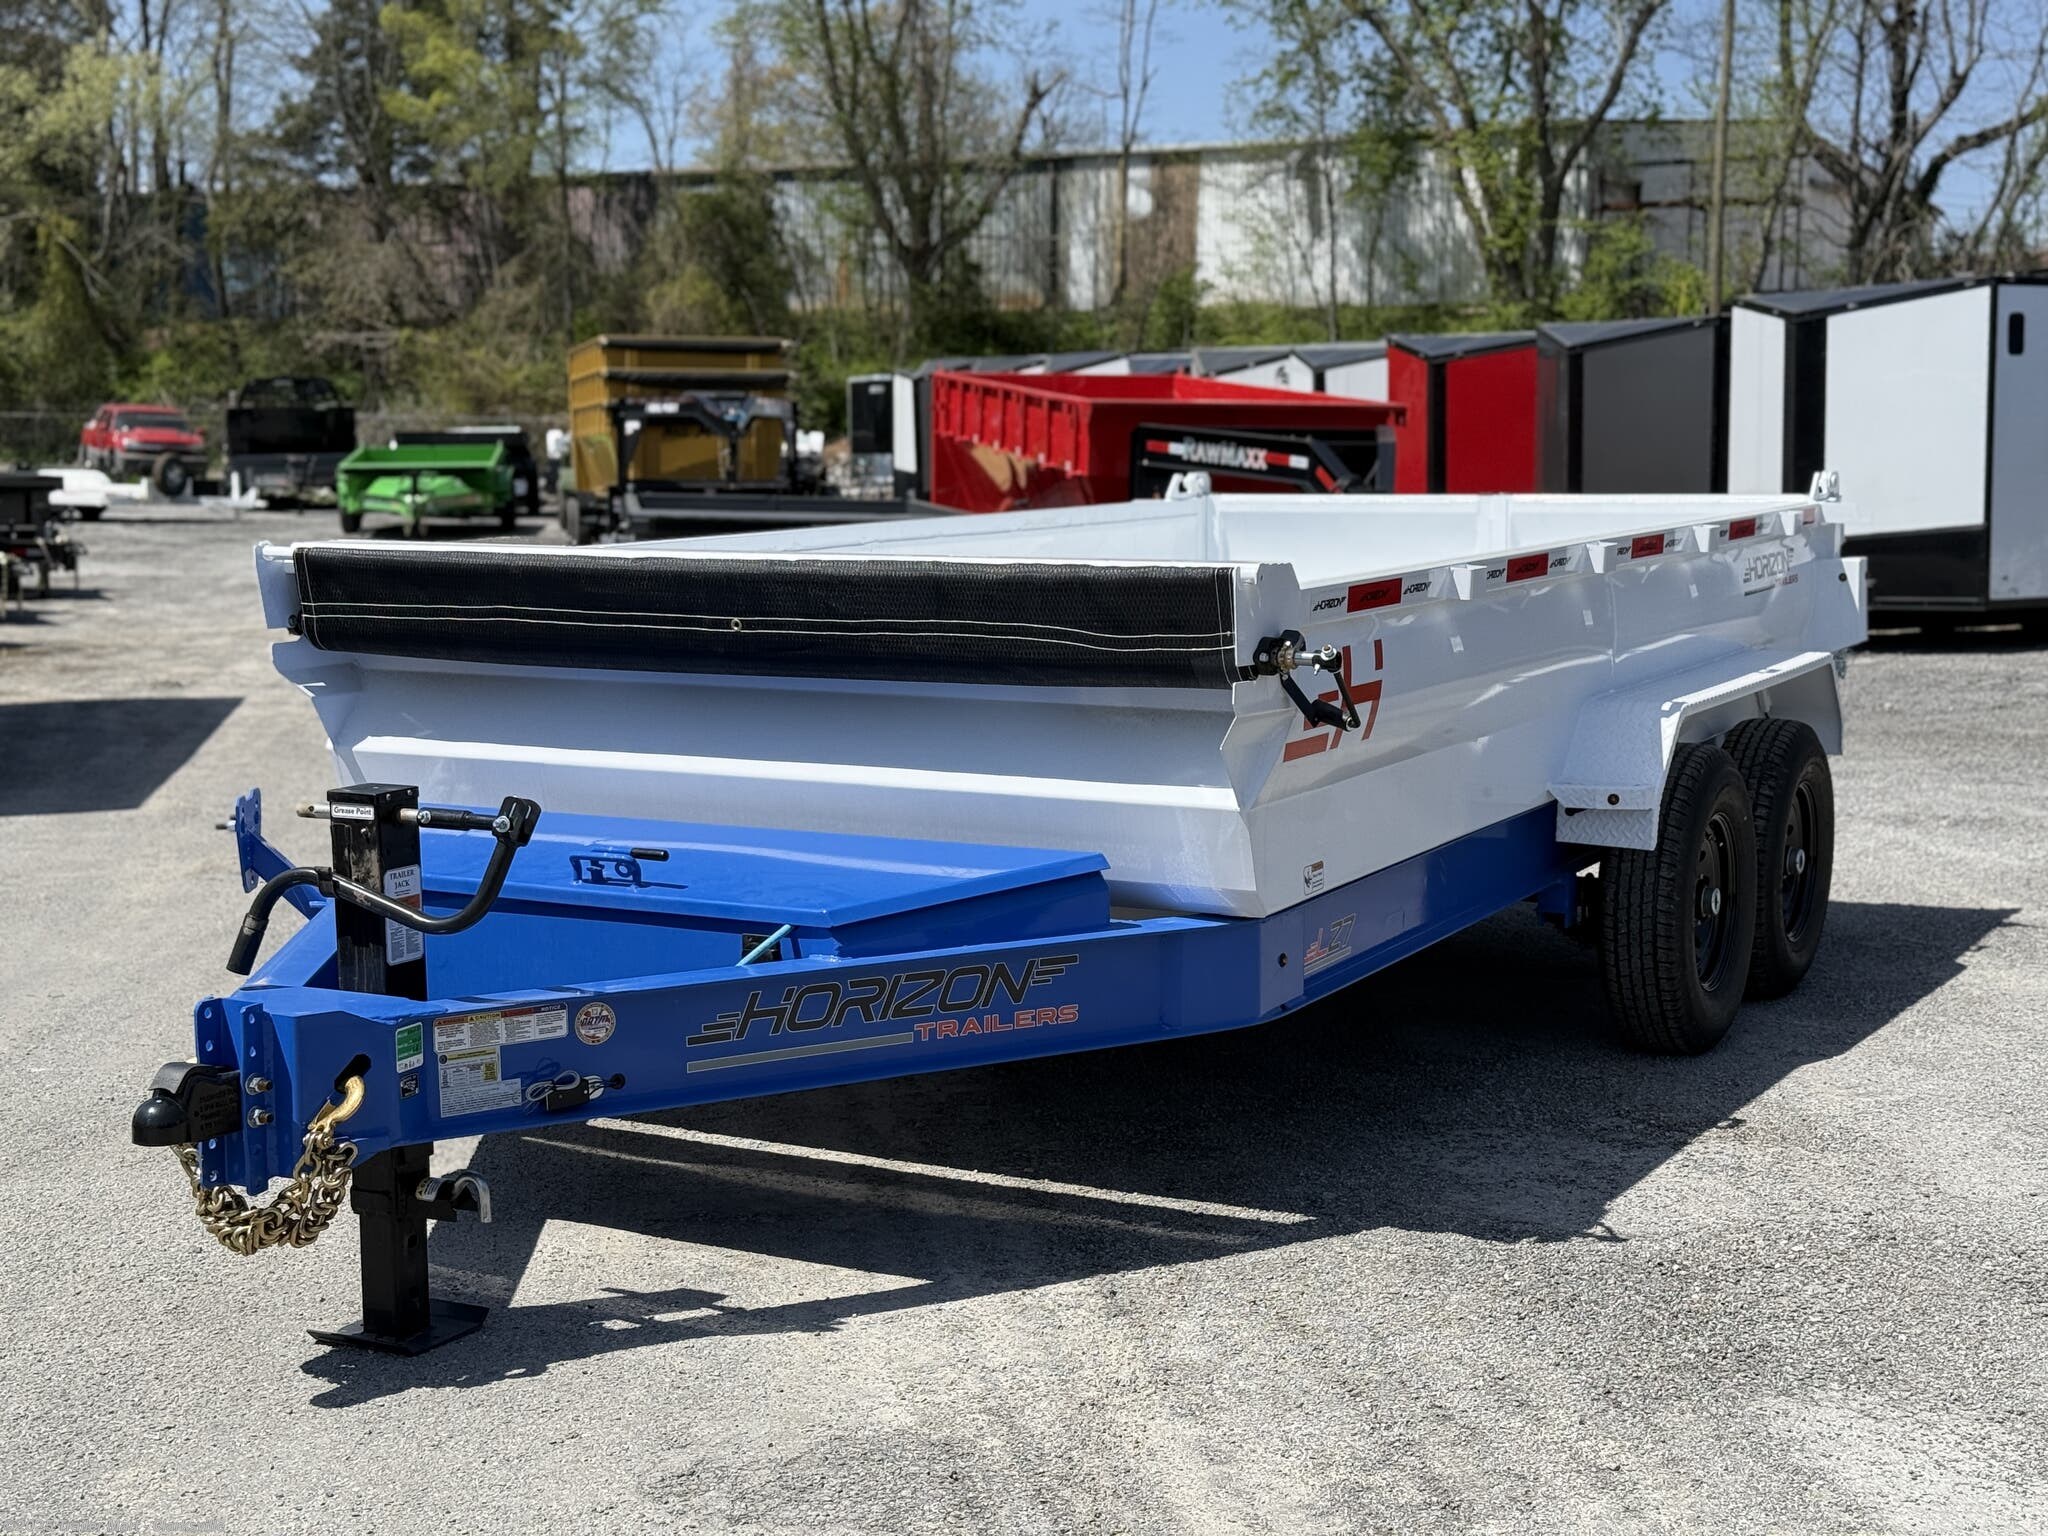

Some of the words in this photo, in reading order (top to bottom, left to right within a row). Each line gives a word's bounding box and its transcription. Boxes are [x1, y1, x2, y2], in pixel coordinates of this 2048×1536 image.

[1182, 437, 1268, 470] RAWMAXX
[1744, 548, 1794, 583] HORIZON
[1486, 568, 1506, 580] ORIZON
[1403, 581, 1431, 595] HORIZON
[1312, 596, 1347, 612] HORIZON
[333, 805, 355, 816] Grease
[356, 806, 373, 817] Point
[389, 868, 415, 882] TRAILER
[394, 879, 411, 890] JACK
[730, 957, 1040, 1043] HORIZON
[540, 1005, 562, 1013] NOTICE
[914, 1004, 1080, 1042] TRAILERS
